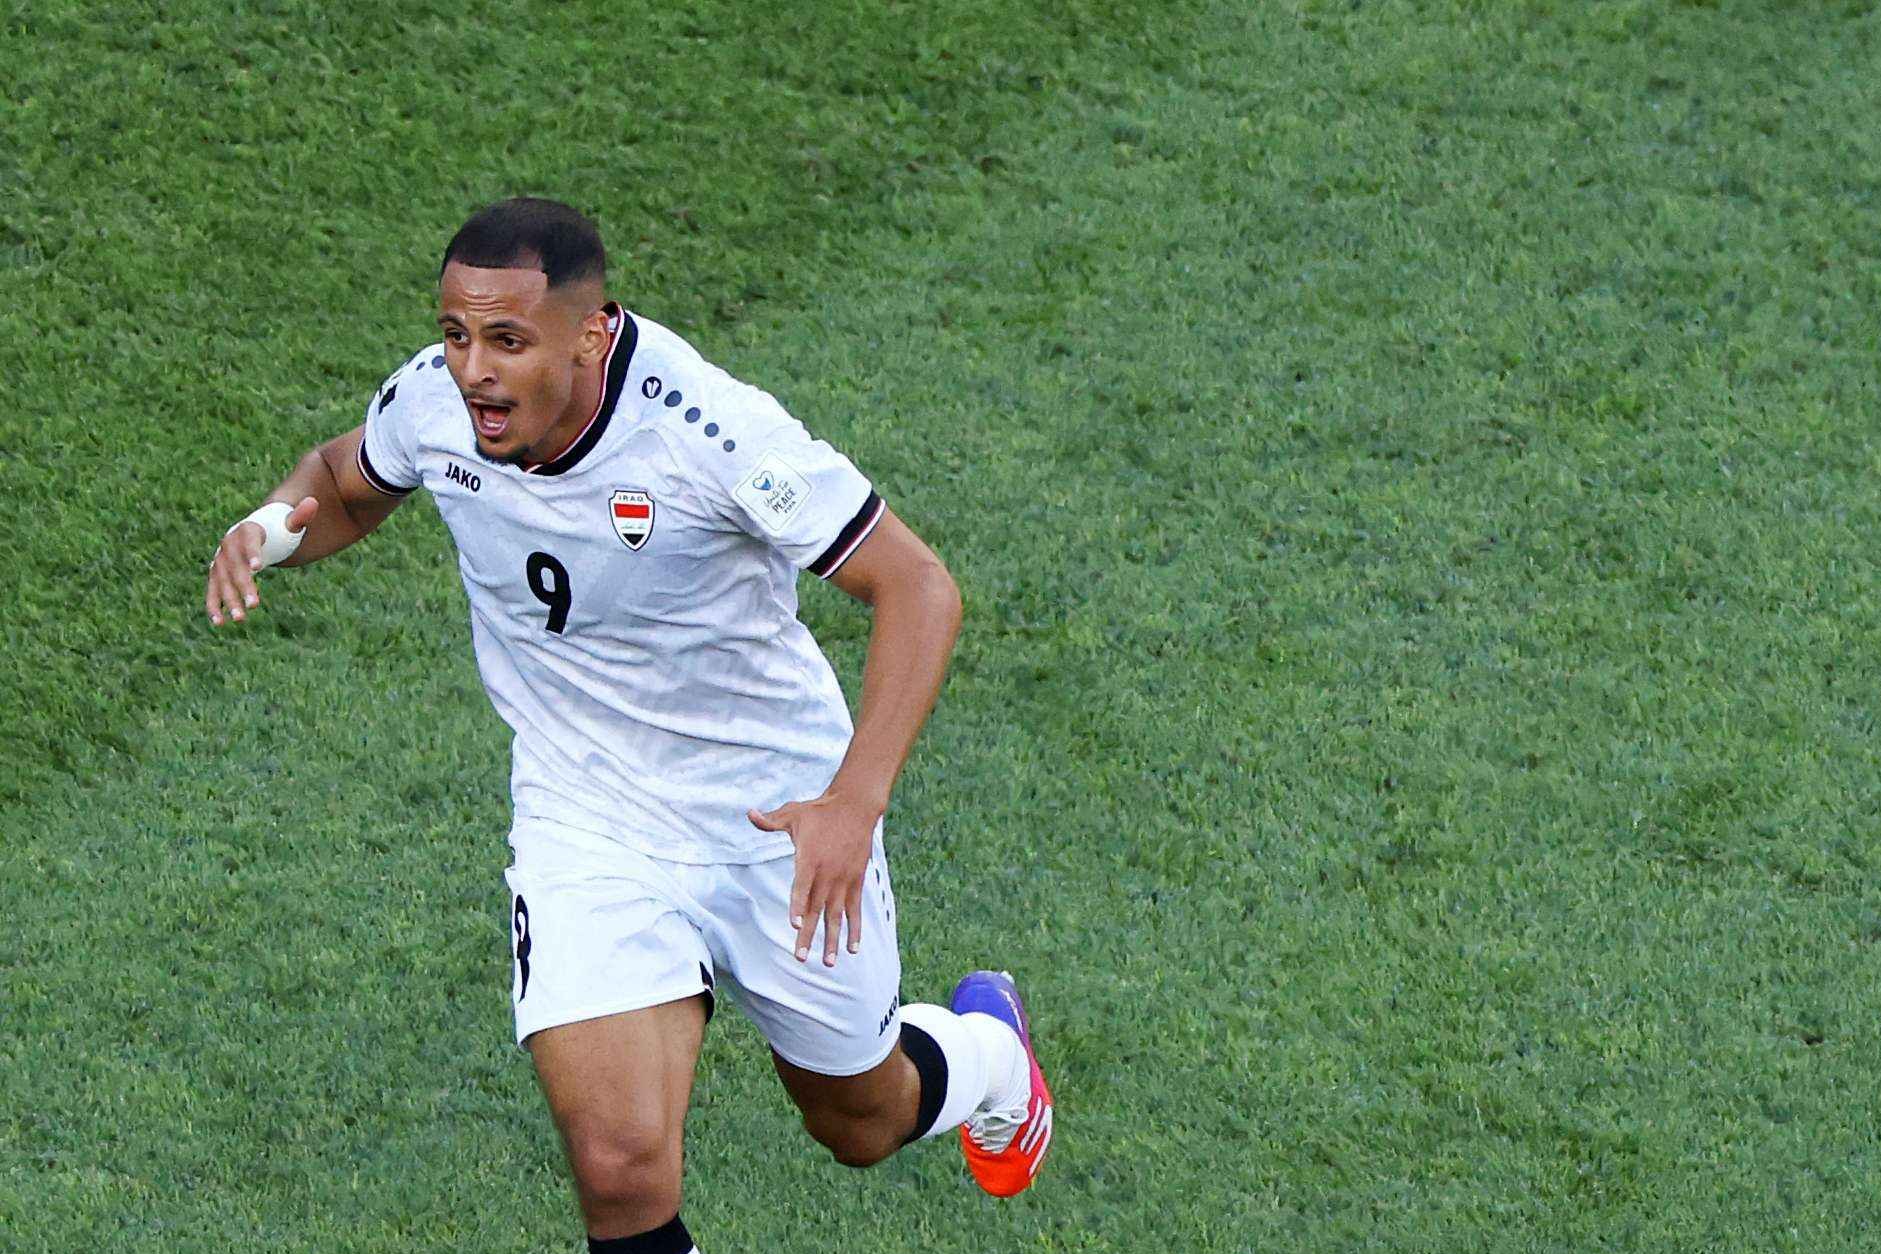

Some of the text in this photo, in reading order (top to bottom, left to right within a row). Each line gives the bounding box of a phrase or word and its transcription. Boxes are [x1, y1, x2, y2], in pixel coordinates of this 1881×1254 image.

[445, 461, 481, 492] JAKO
[618, 494, 645, 503] IRAQ
[526, 551, 572, 635] 9
